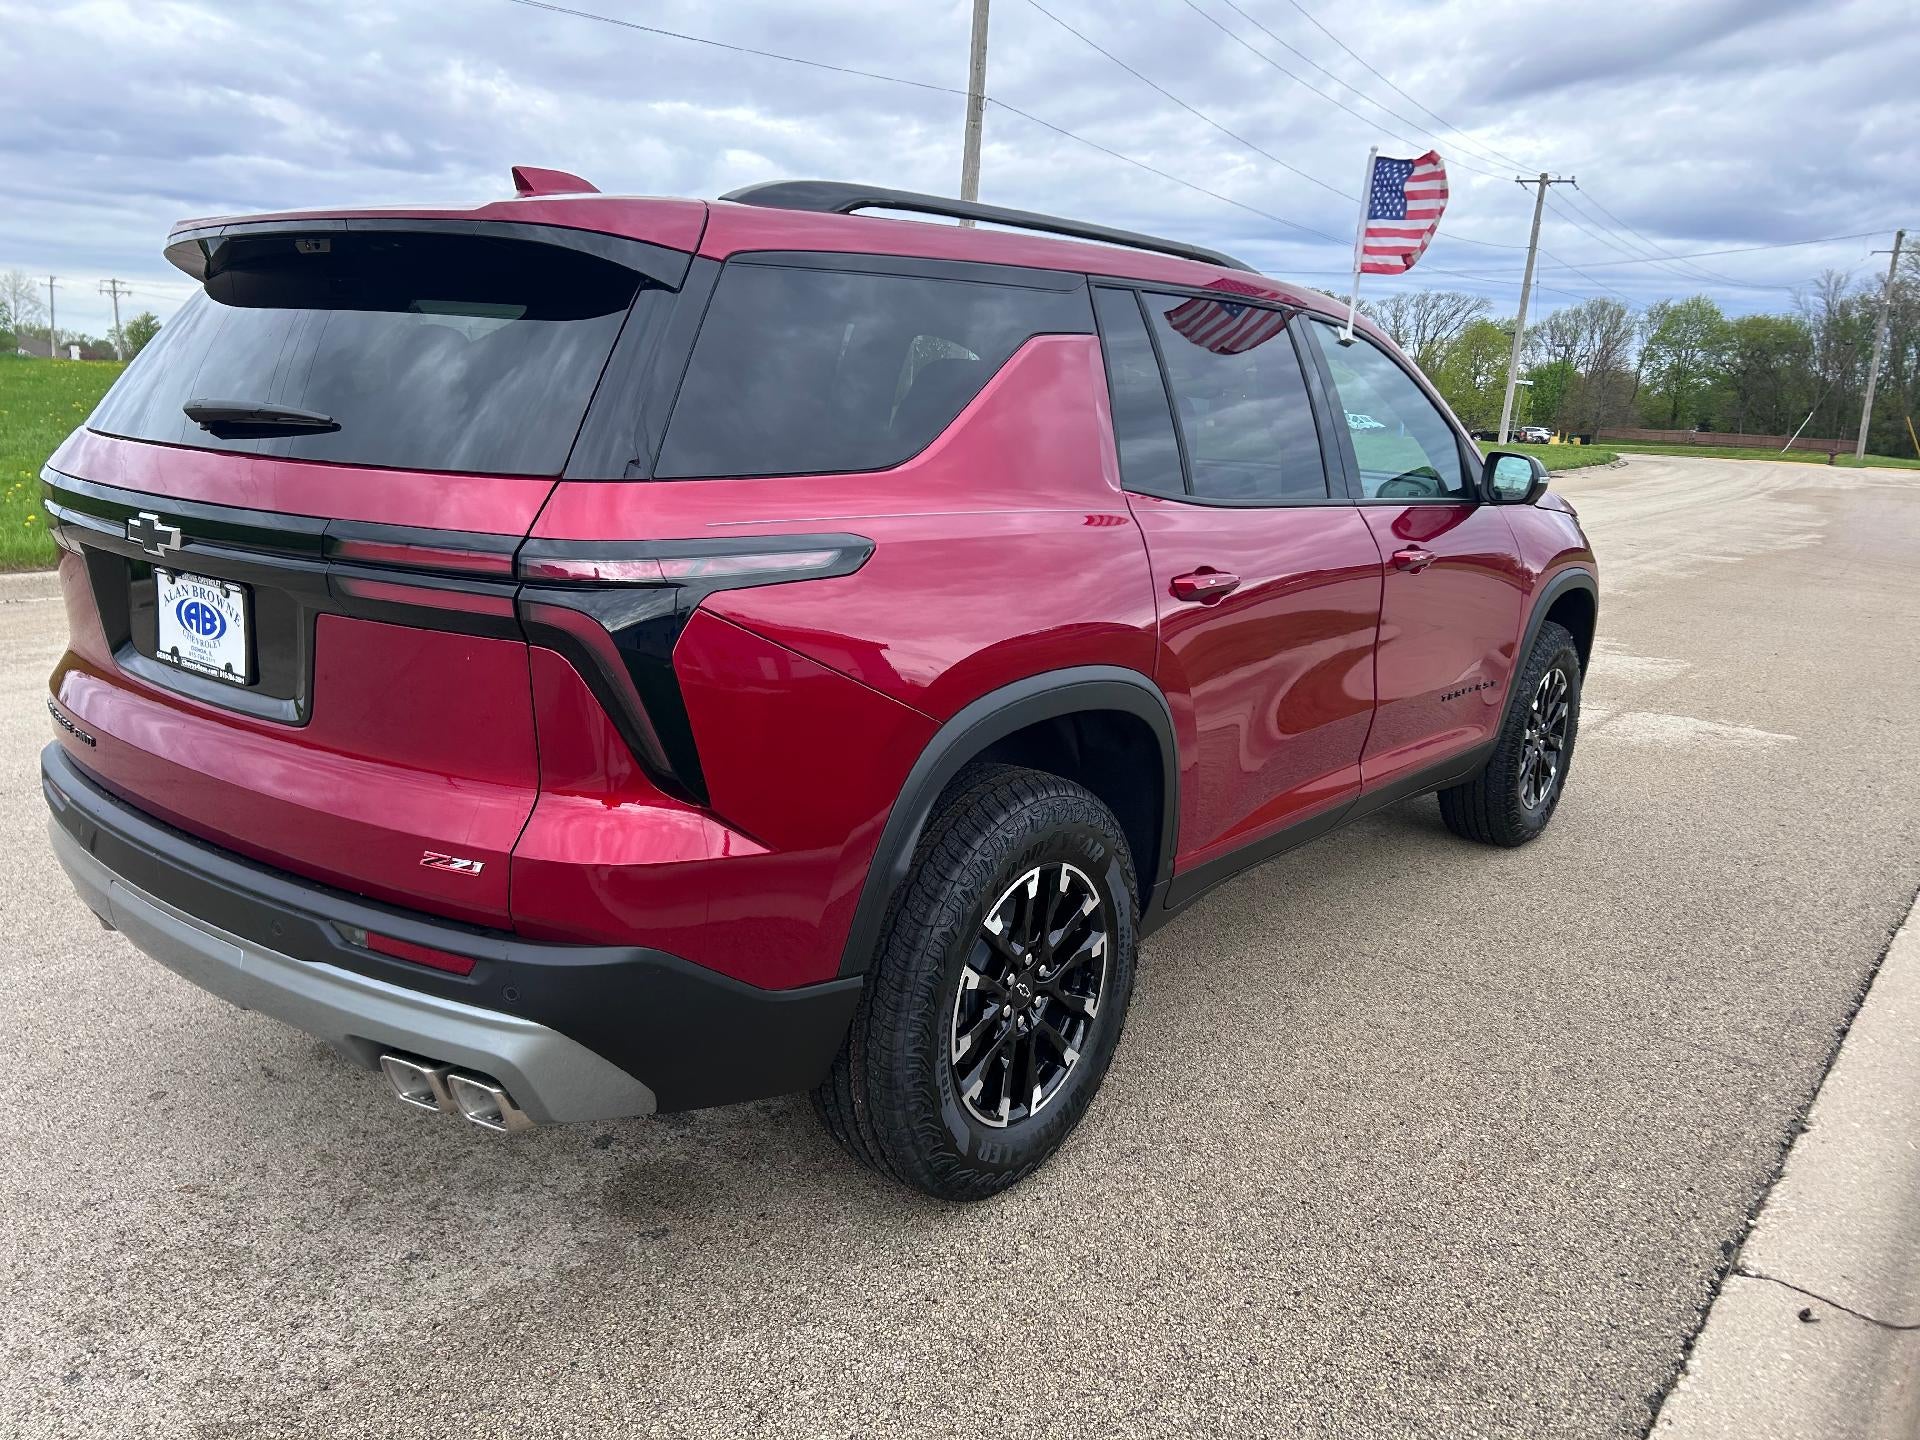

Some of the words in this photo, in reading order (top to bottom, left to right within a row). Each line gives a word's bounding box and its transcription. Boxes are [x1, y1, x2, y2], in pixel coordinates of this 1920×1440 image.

[163, 584, 189, 606] ALAN
[192, 585, 241, 628] BROWNE
[184, 602, 217, 636] AB
[420, 850, 485, 876] Z71
